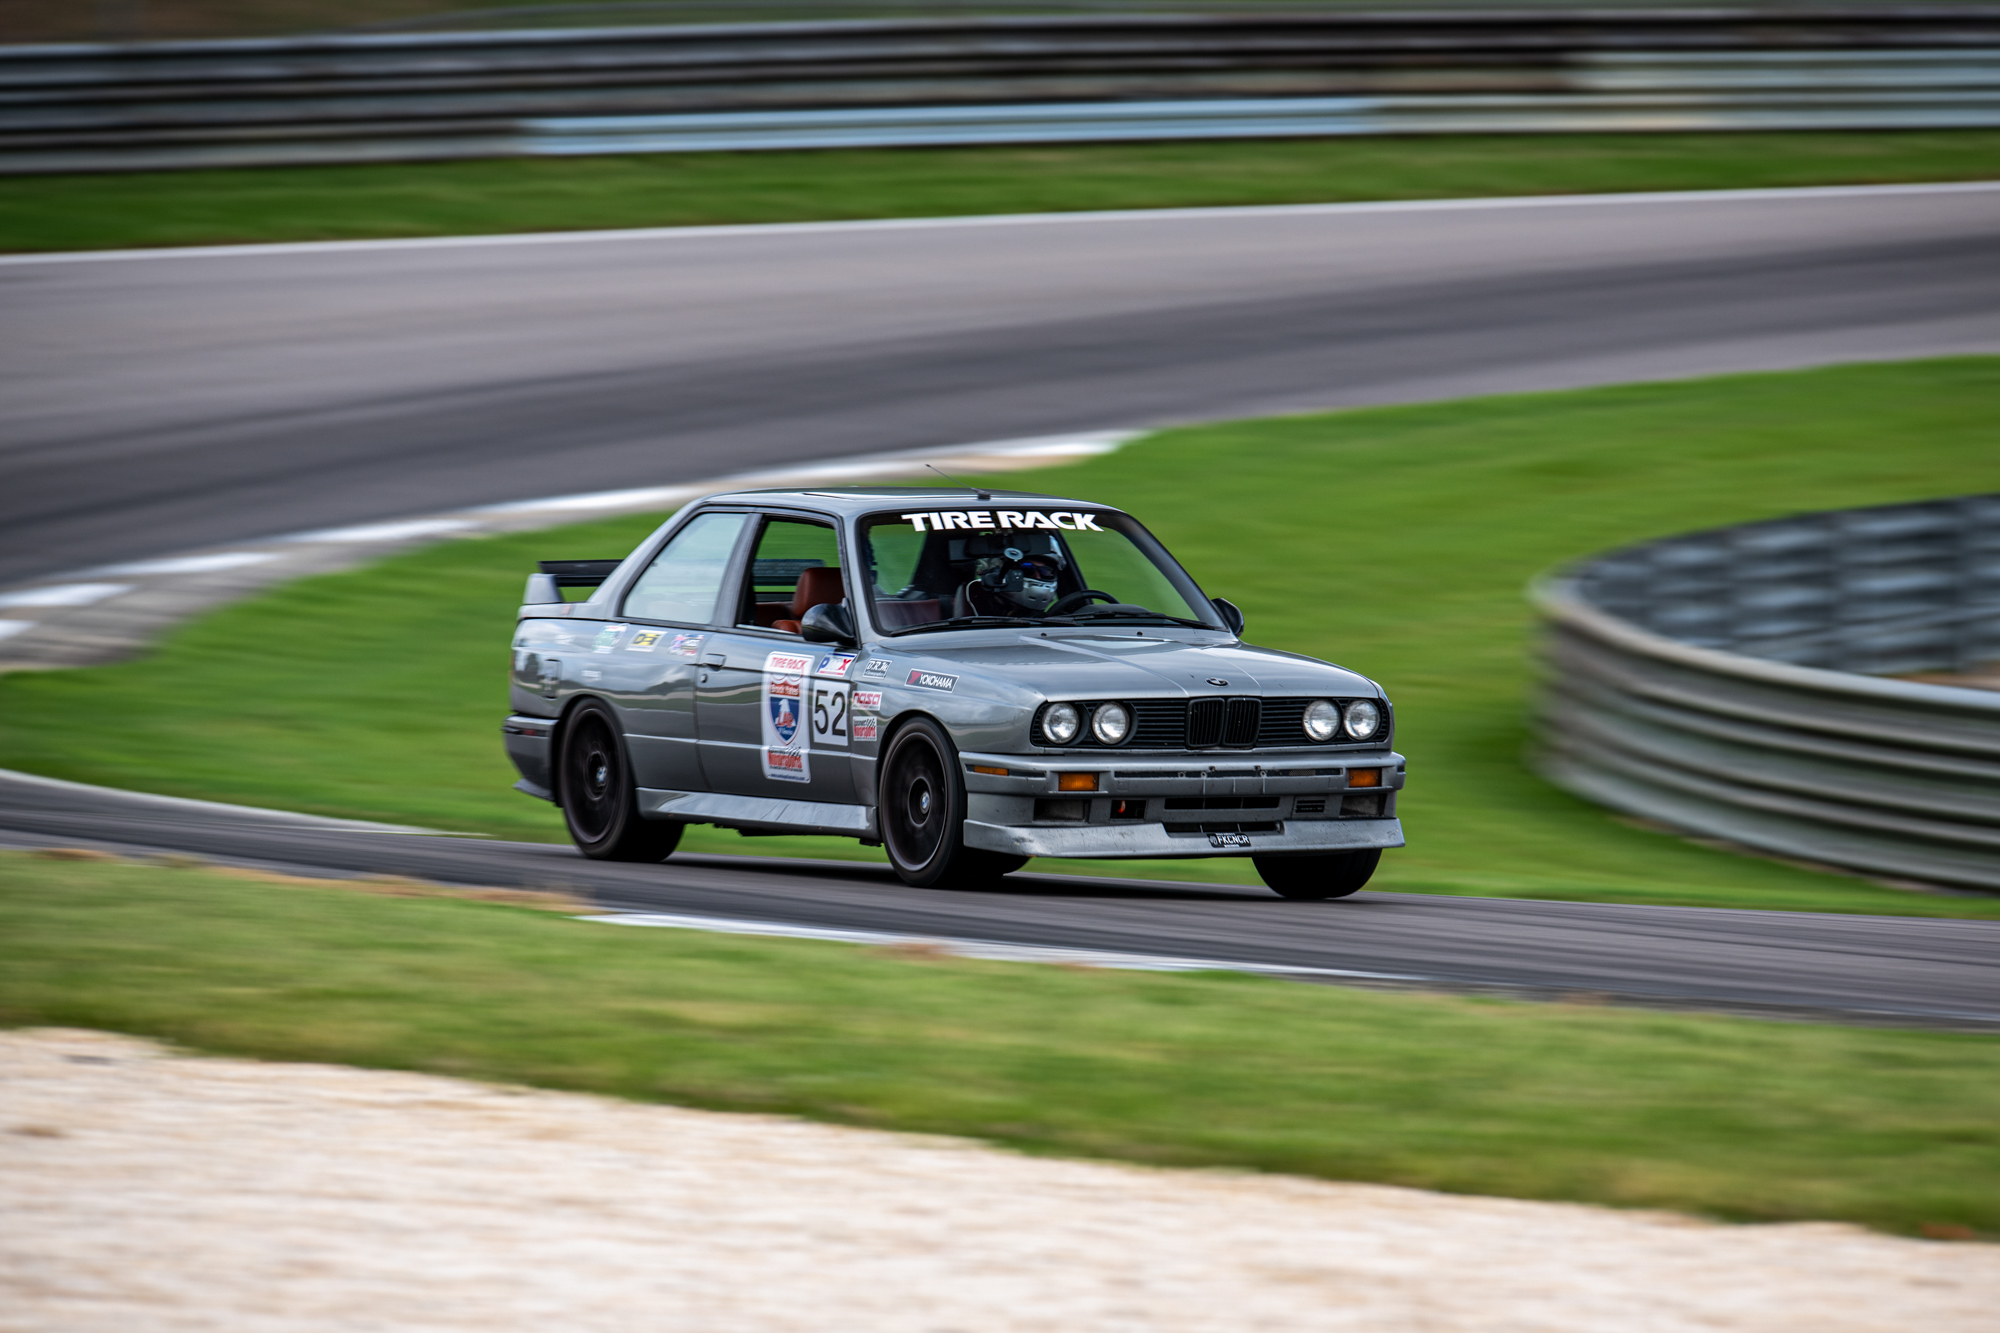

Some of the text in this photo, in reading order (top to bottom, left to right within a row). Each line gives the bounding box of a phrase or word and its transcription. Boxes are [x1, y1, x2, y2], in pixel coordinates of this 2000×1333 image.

[901, 511, 1105, 532] TIRE RACK
[770, 657, 788, 668] TIRE
[785, 659, 808, 670] RACK
[920, 673, 953, 688] YOKOHAMA
[814, 690, 847, 736] 52
